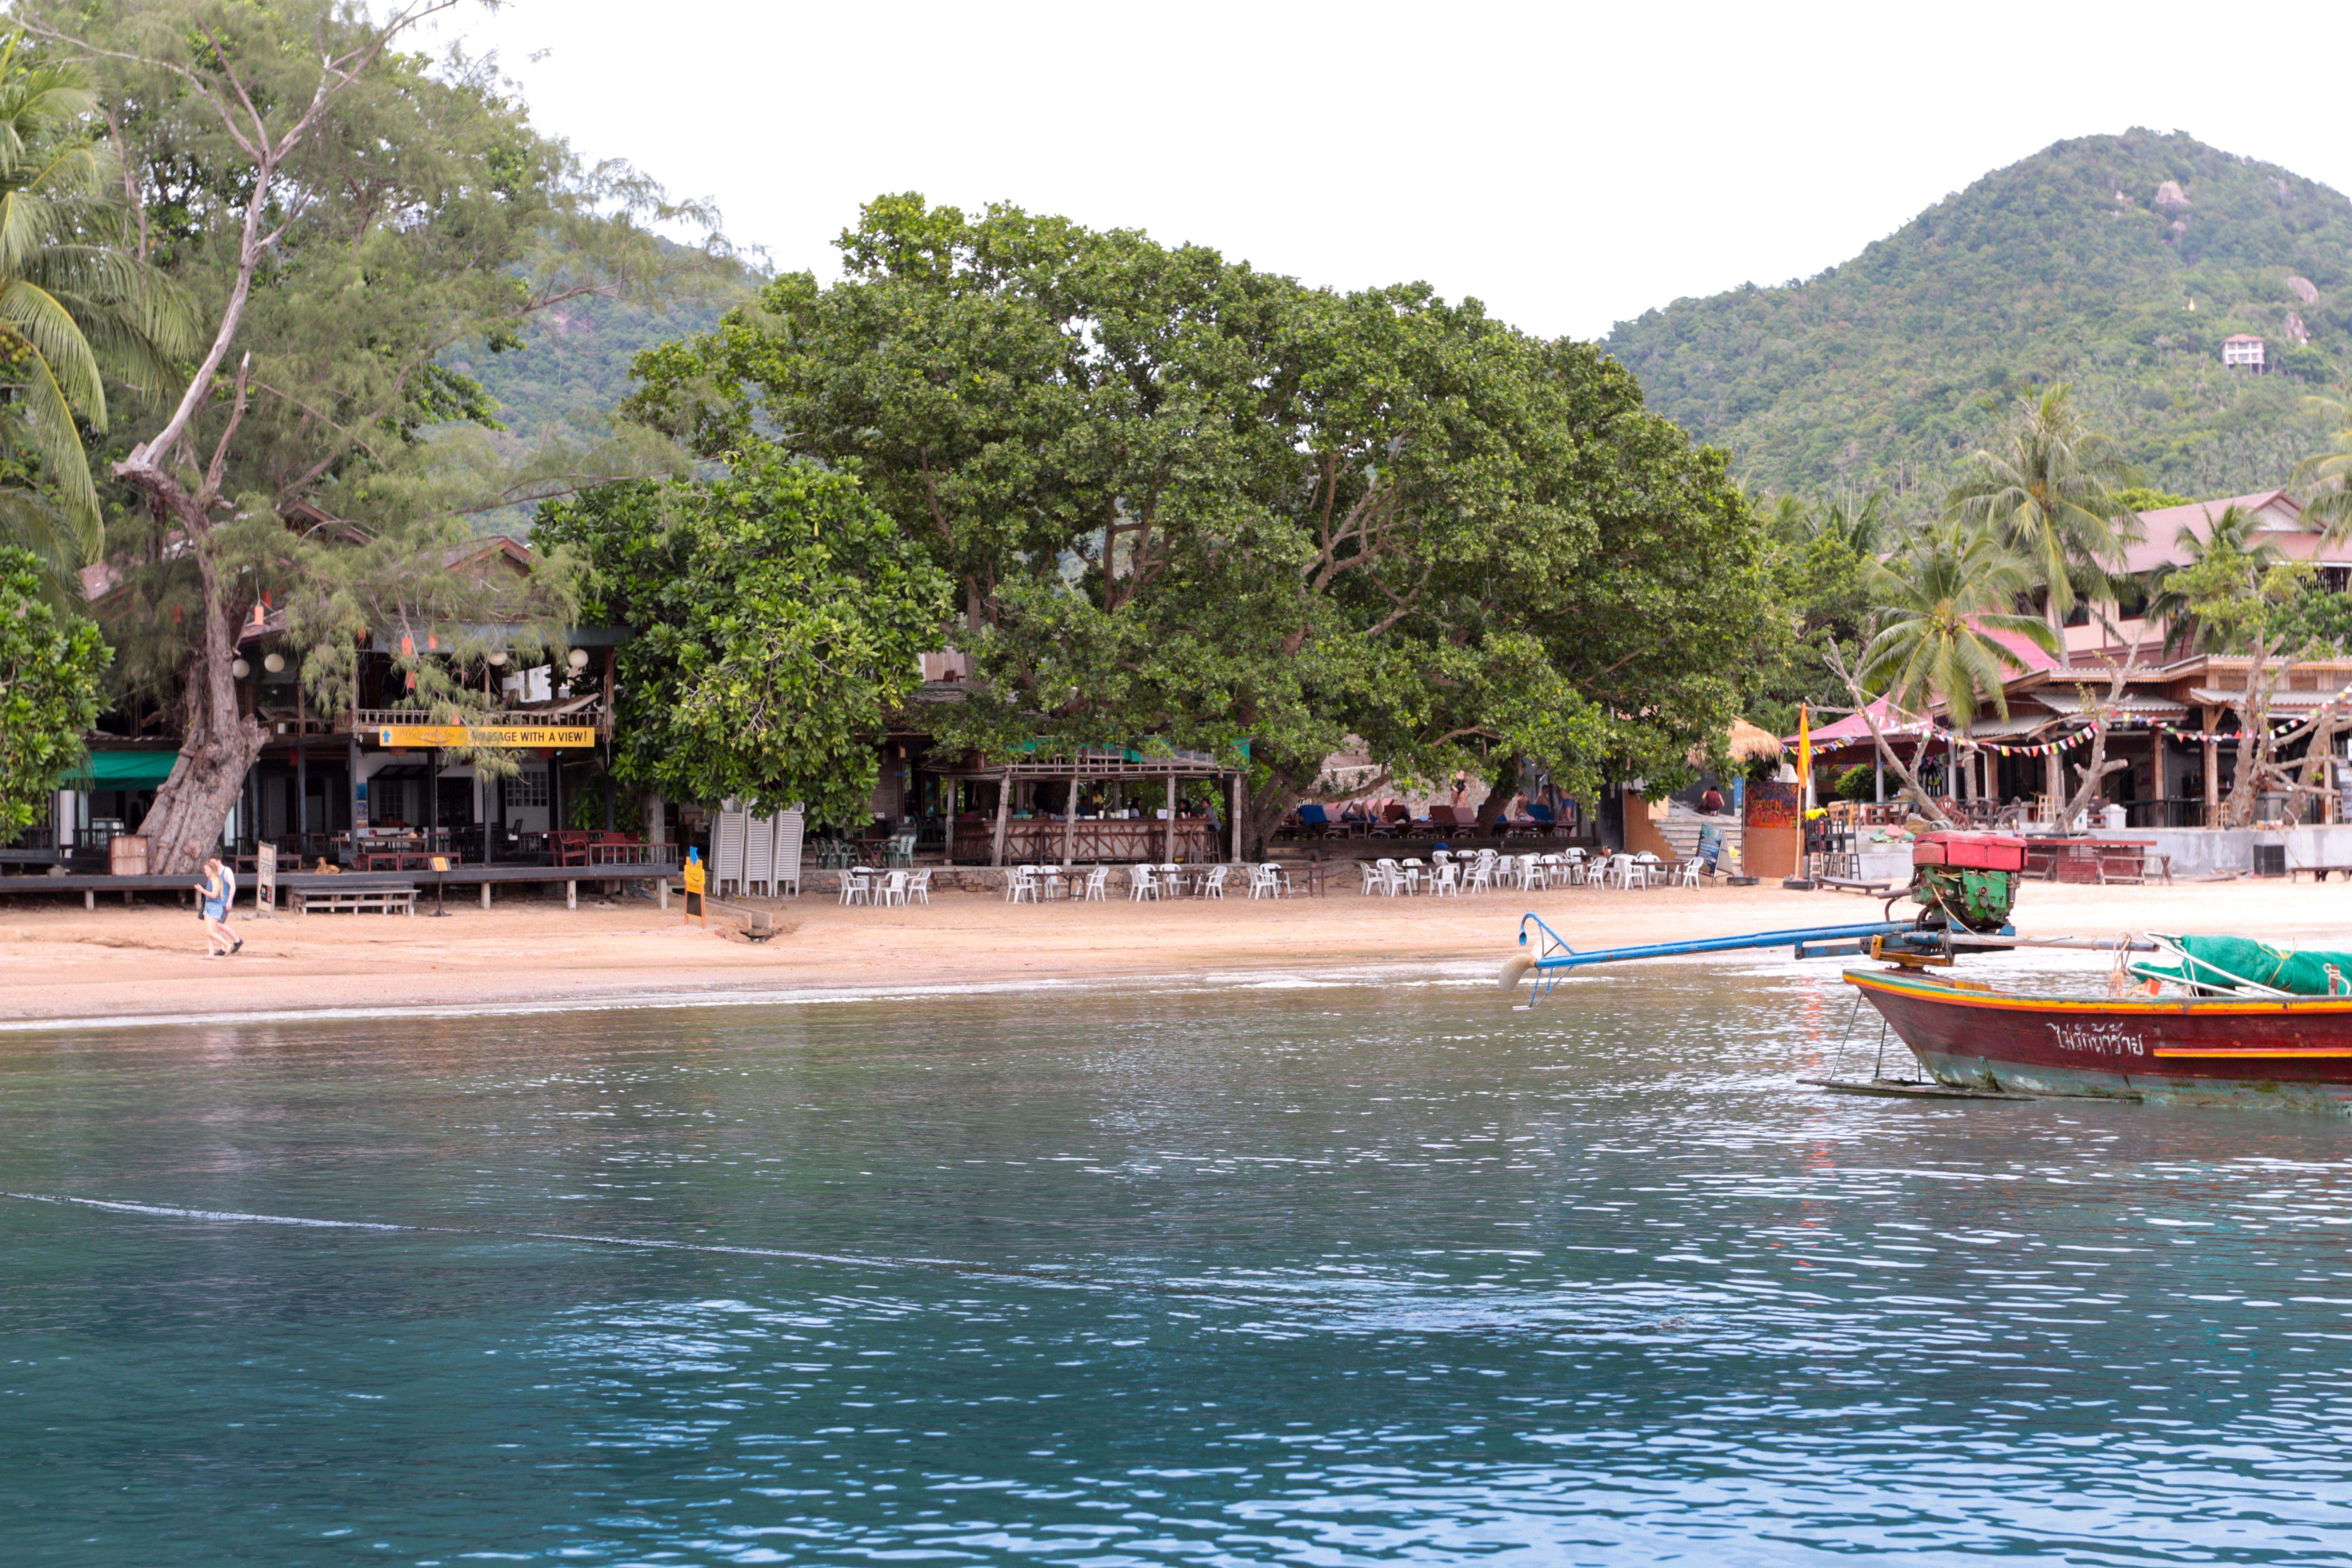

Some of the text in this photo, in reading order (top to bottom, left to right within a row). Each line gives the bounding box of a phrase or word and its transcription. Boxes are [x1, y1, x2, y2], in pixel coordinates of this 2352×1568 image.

[472, 731, 587, 742] MSAGE WITH A VIEW!
